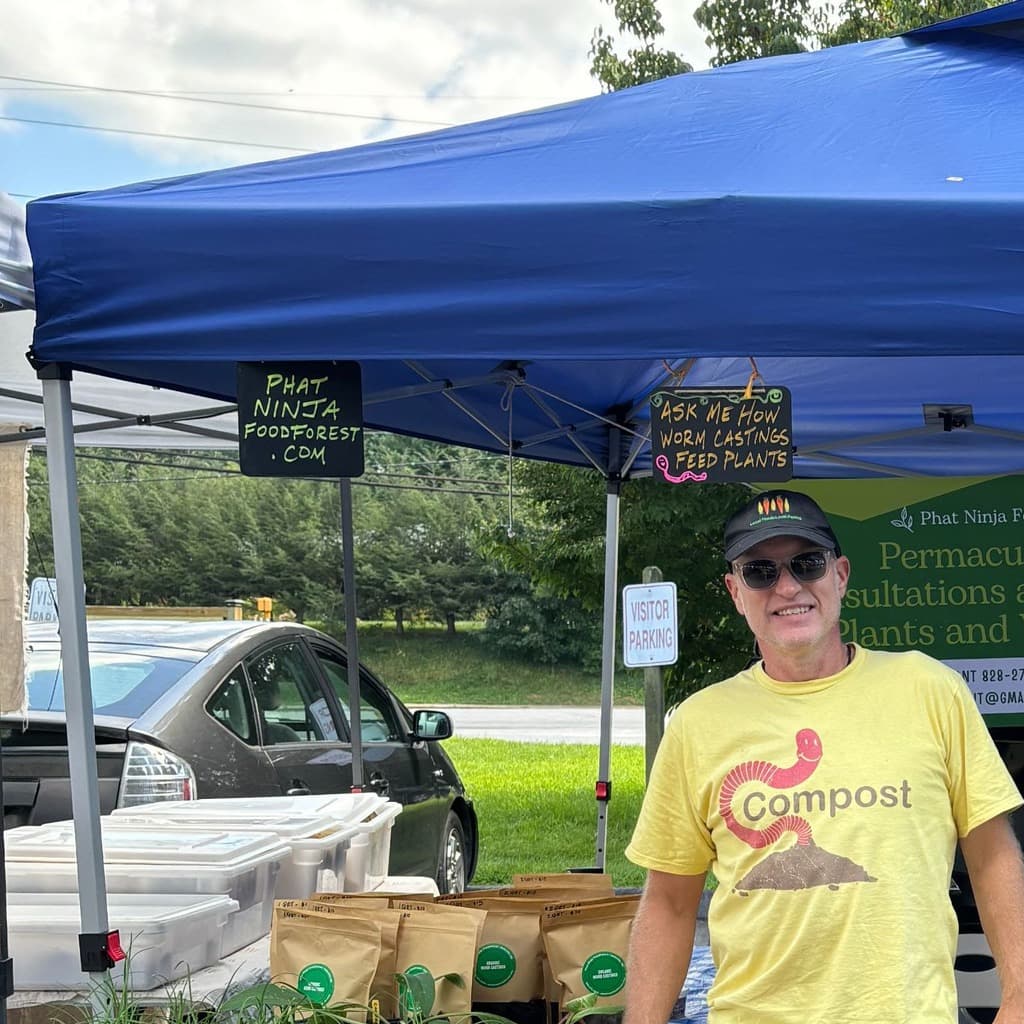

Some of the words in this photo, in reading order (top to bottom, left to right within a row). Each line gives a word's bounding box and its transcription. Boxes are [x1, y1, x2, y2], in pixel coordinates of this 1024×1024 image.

[266, 374, 328, 395] PHAT
[254, 398, 340, 420] NINJA
[661, 400, 697, 423] ASK
[706, 401, 734, 425] ME
[737, 400, 780, 427] HOW
[244, 422, 360, 442] FOODFOREST
[660, 428, 706, 450] WORM
[714, 427, 789, 447] CASTINGS
[272, 445, 326, 465] .COM
[675, 450, 718, 470] FEED
[723, 449, 787, 471] PLANTS
[920, 510, 959, 526] Phat
[964, 508, 1007, 527] Ninja
[841, 579, 1006, 609] sultations
[631, 599, 670, 622] VISITOR
[629, 627, 672, 651] PARKING
[946, 615, 1010, 645] and
[743, 779, 912, 822] Compost
